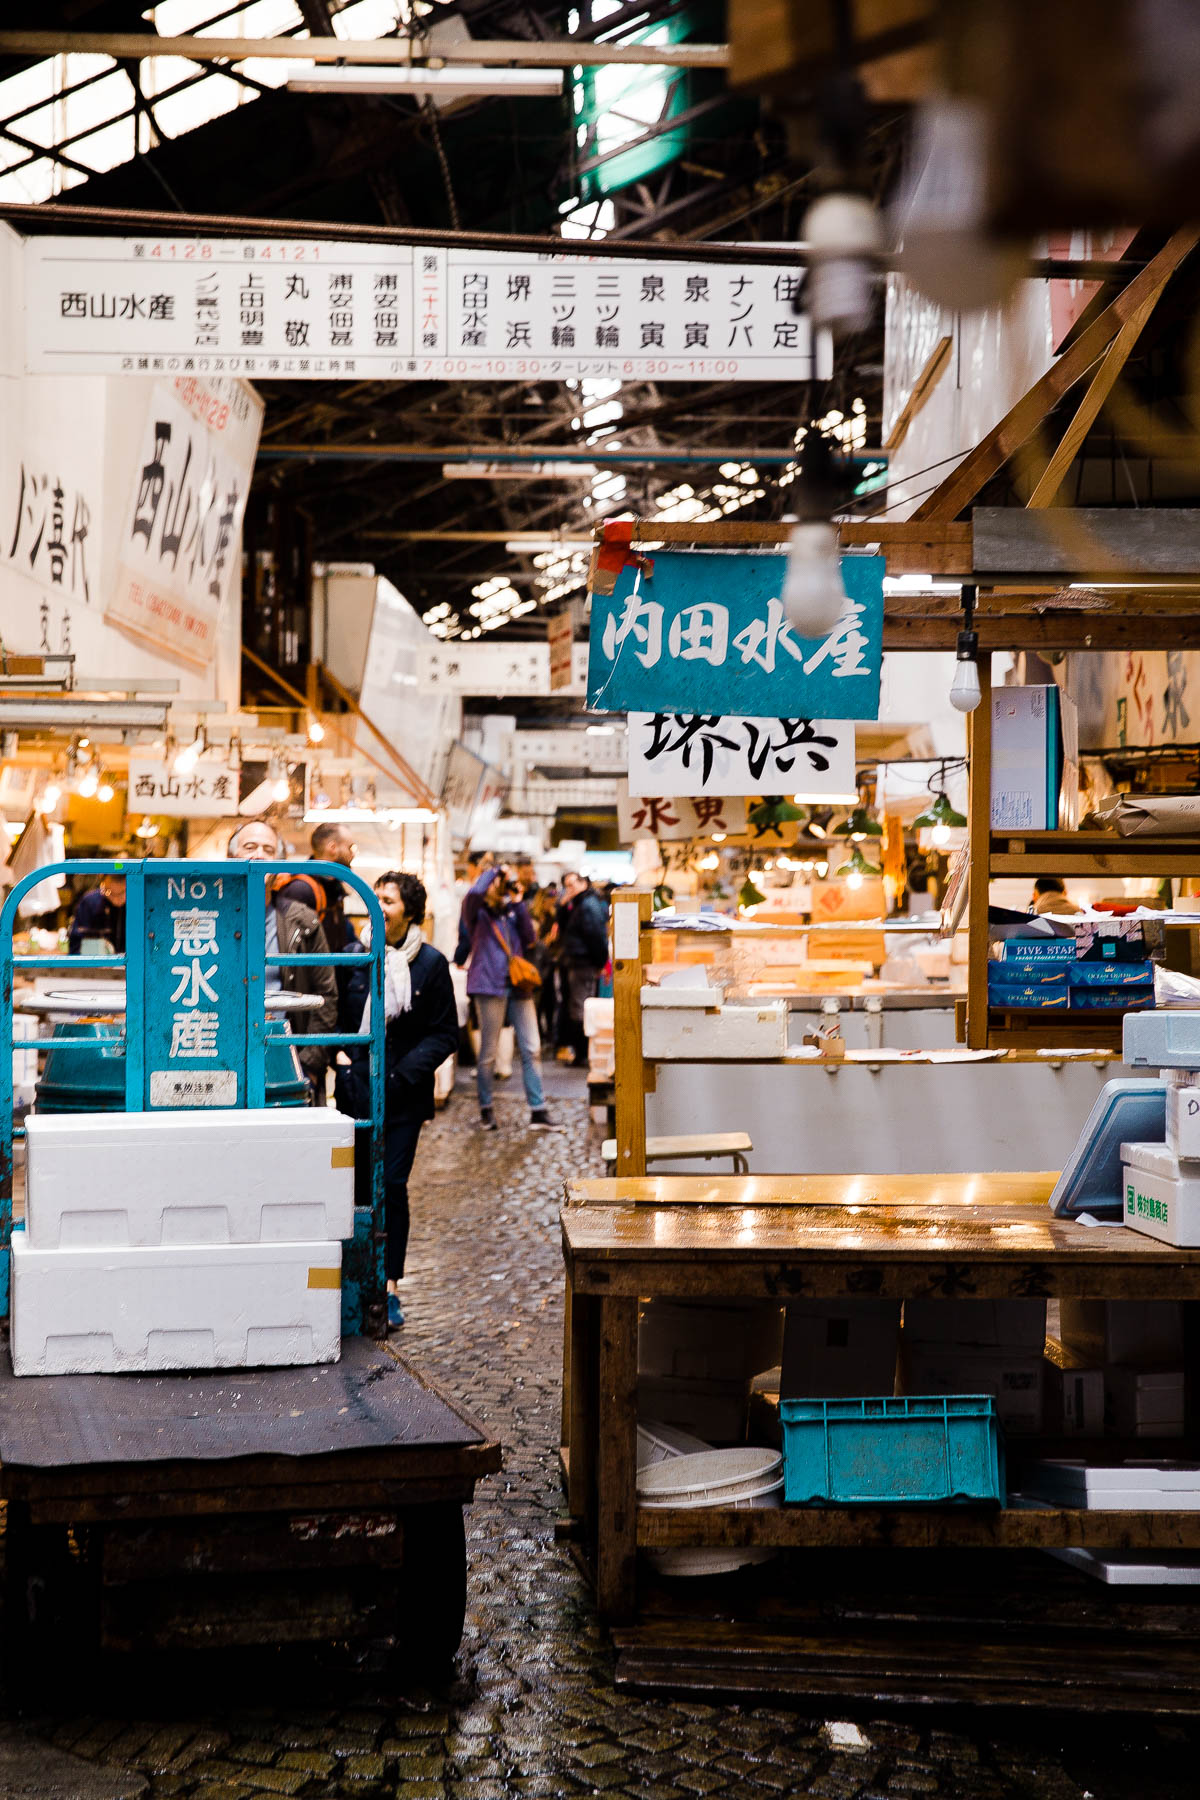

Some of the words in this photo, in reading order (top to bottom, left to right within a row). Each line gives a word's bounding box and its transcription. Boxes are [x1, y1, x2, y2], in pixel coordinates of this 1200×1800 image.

[60, 292, 175, 320] 西山水産
[239, 272, 264, 346] 上田明豊
[285, 272, 310, 347] 丸敬
[461, 273, 488, 347] 内田水産
[506, 274, 532, 349] 堺浜
[551, 274, 576, 348] 三ツ輪
[595, 274, 620, 348] 三ツ輪
[640, 274, 665, 349] 泉寅
[684, 274, 710, 349] 泉寅
[728, 275, 753, 349] ナンバ
[602, 595, 872, 677] 内田水産
[134, 773, 232, 801] 西山水産
[169, 907, 220, 1059] 恵水産
[1016, 946, 1043, 955] FIVE
[1047, 946, 1075, 955] STAR
